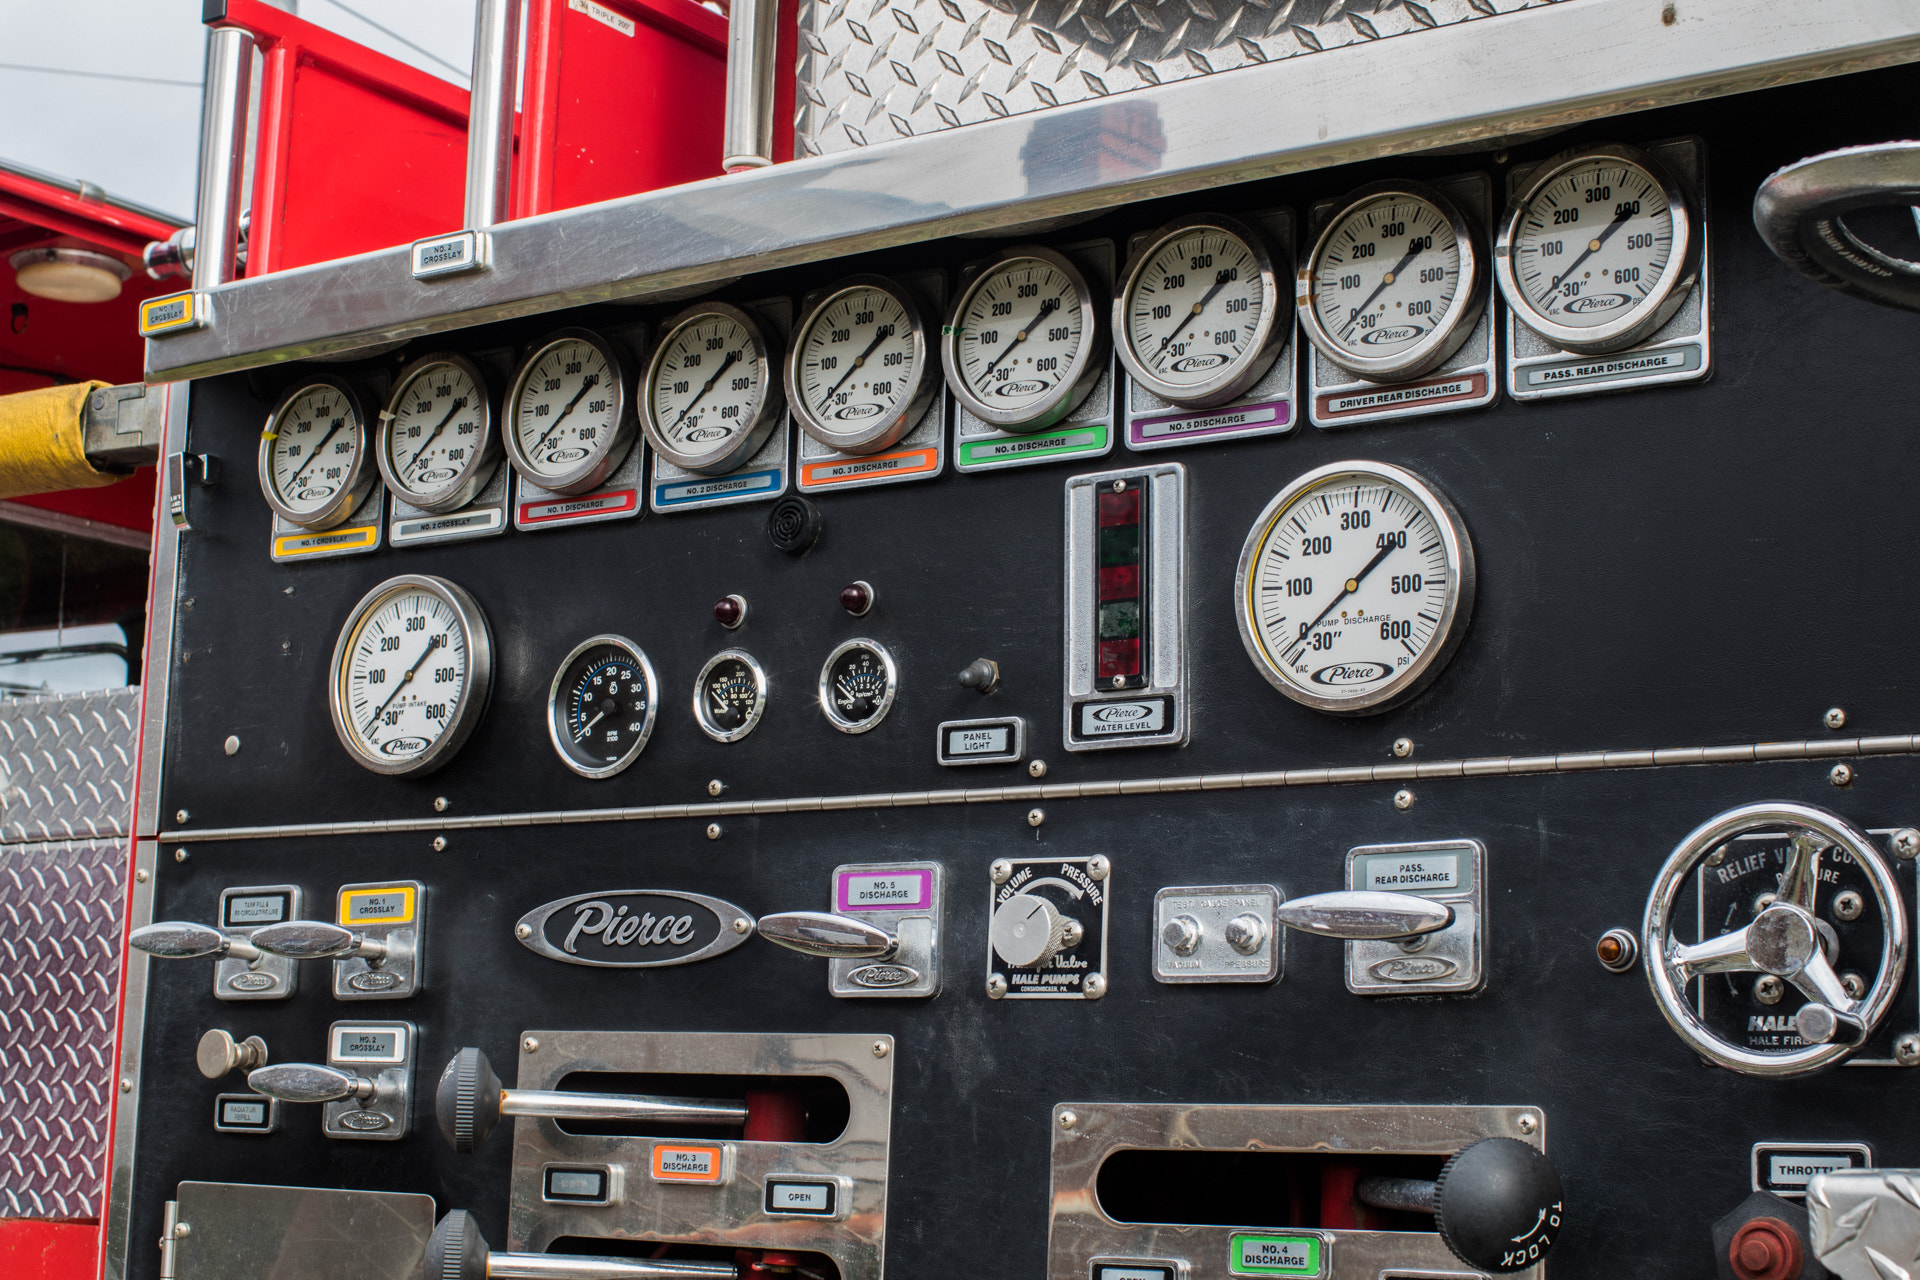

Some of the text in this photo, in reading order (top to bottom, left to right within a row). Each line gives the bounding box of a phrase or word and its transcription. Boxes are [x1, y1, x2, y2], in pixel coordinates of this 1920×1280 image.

[592, 6, 614, 23] TRIPLE
[1585, 186, 1610, 203] 300
[1381, 222, 1404, 238] 300
[1627, 233, 1653, 250] 500
[424, 251, 461, 264] CROSSLAY
[1191, 255, 1212, 270] 300
[1420, 267, 1443, 283] 500
[1614, 267, 1640, 284] 600
[1018, 284, 1037, 298] 300
[1226, 298, 1247, 313] 500
[1408, 300, 1431, 316] 600
[1578, 298, 1615, 311] Pierce
[151, 310, 182, 323] CROSSLAY
[855, 311, 874, 325] 300
[1049, 327, 1068, 341] 500
[1214, 330, 1236, 345] 600
[1375, 330, 1409, 342] Pierce
[706, 337, 723, 350] 300
[884, 353, 902, 366] 500
[1037, 358, 1057, 371] 600
[1184, 357, 1215, 370] Pierce
[565, 361, 581, 375] 300
[1544, 357, 1668, 380] PASS. REAR DISCHARGE
[732, 377, 749, 391] 500
[873, 381, 892, 395] 600
[436, 385, 451, 397] 300
[1340, 384, 1461, 408] DRIVER REAR DISCHARGE
[316, 406, 330, 418] 300
[589, 400, 605, 413] 500
[721, 406, 739, 418] 600
[458, 423, 473, 435] 500
[1170, 423, 1184, 431] NO.
[1193, 415, 1245, 428] DISCHARGE
[580, 428, 595, 440] 600
[336, 442, 350, 454] 500
[995, 446, 1008, 454] NO.
[1018, 439, 1066, 450] DISCHARGE
[449, 448, 464, 461] 600
[326, 467, 340, 479] 600
[854, 461, 898, 472] DISCHARGE
[706, 481, 747, 492] DISCHARGE
[566, 501, 604, 511] DISCHARGE
[437, 518, 470, 528] CROSSLAY
[1340, 510, 1370, 530] 300
[316, 536, 347, 545] CROSSLAY
[1302, 536, 1331, 556] 200
[1286, 577, 1312, 597] 100
[1391, 574, 1422, 594] 500
[406, 616, 425, 632] 300
[1344, 614, 1391, 624] DISCHARGE
[1299, 622, 1308, 640] 0
[1380, 620, 1411, 640] 600
[381, 636, 399, 652] 200
[1398, 654, 1409, 667] psi
[435, 667, 454, 683] 500
[606, 667, 617, 676] 20
[621, 670, 631, 679] 25
[1296, 665, 1308, 673] VAC
[1329, 667, 1374, 682] Pierce
[369, 669, 385, 684] 100
[593, 676, 602, 685] 15
[631, 683, 641, 692] 30
[584, 693, 592, 701] 10
[426, 704, 445, 719] 600
[635, 701, 645, 710] 35
[581, 713, 586, 721] 5
[1106, 708, 1138, 720] Pierce
[629, 723, 640, 731] 40
[1094, 724, 1122, 732] WATER
[963, 732, 992, 741] PANEL
[392, 740, 420, 752] Pierce
[965, 741, 990, 751] LIGHT
[1400, 864, 1424, 872] PASS.
[1717, 852, 1766, 884] RELIEF
[996, 867, 1033, 903] VOLUME
[1061, 863, 1103, 906] PRESSURE
[1375, 873, 1449, 884] REAR DISCHARGE
[860, 890, 908, 899] DISCHARGE
[369, 898, 381, 906] NO.
[360, 906, 395, 914] CROSSLAY
[564, 901, 695, 953] Pierce
[1055, 954, 1088, 968] Valve
[1166, 961, 1201, 969] VACUUM
[1225, 960, 1269, 969] PRESSURE
[862, 968, 901, 983] Pierce
[1011, 974, 1079, 985] HALE PUMPS
[360, 1036, 371, 1044] NO.
[1749, 1036, 1779, 1045] HALE
[350, 1044, 385, 1052] CROSSLAY
[676, 1154, 696, 1162] NO. 3
[663, 1163, 708, 1171] DISCHARGE
[1779, 1166, 1844, 1175] THROTT
[788, 1193, 811, 1201] OPEN
[1501, 1201, 1562, 1266] TO LOCK
[1262, 1245, 1288, 1254] NO. 4
[1245, 1256, 1305, 1265] DISCHARGE
